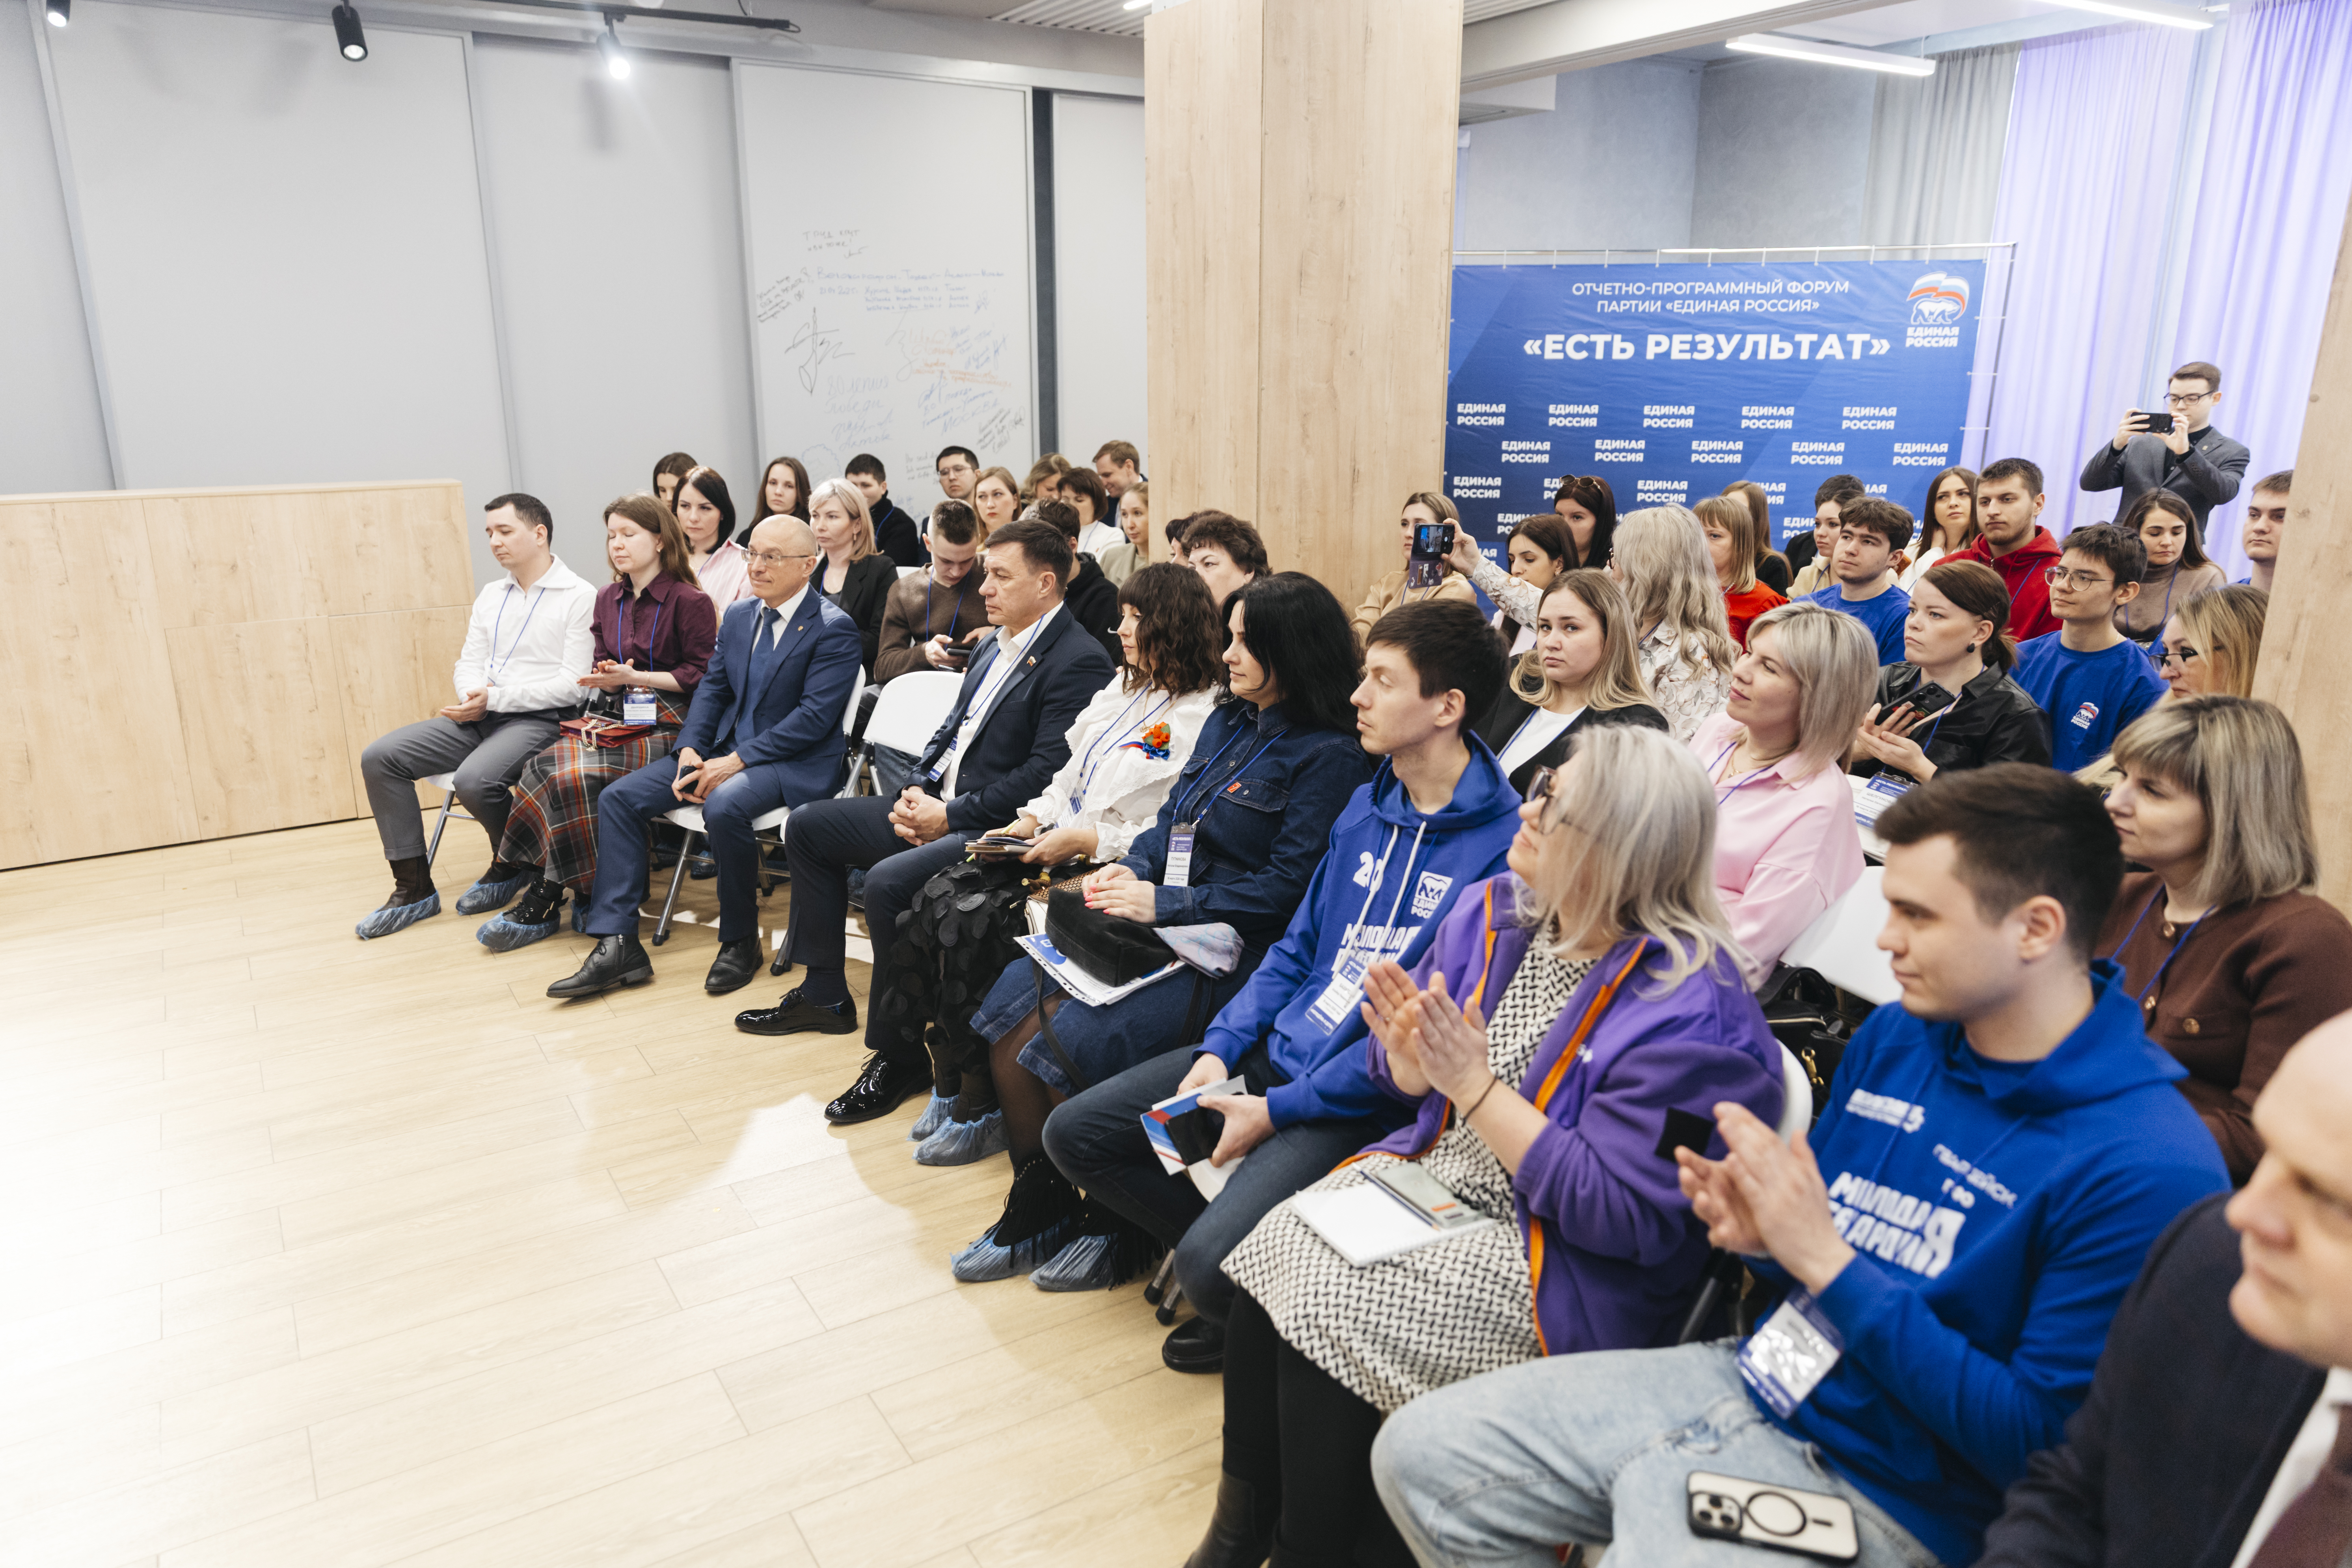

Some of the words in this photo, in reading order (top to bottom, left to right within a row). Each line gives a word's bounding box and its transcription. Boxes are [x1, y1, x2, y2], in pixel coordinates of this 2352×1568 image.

[1572, 279, 1783, 295] ОТЧЕТНО-ПРОГРАММНЫЙ
[1786, 280, 1849, 294] ФОРУМ
[1597, 300, 1661, 313] ПАРТИИ
[1665, 300, 1740, 315] «ЕДИНАЯ
[1744, 299, 1820, 313] РОССИЯ»
[1907, 326, 1960, 337] ЕДИНАЯ
[1523, 333, 1635, 360] «ЕСТЬ
[1646, 333, 1891, 361] РЕЗУЛЬТАТ»
[1905, 337, 1958, 348] РОССИЯ
[1457, 403, 1506, 414] ЕДИНАЯ
[1549, 404, 1599, 415] ЕДИНАЯ
[1643, 405, 1695, 416] ЕДИНАЯ
[1741, 406, 1795, 417] ЕДИНАЯ
[1842, 407, 1897, 418] ЕДИНАЯ
[1457, 416, 1505, 426] РОССИЯ
[1548, 417, 1598, 427] РОССИЯ
[1643, 418, 1693, 428] РОССИЯ
[1741, 419, 1793, 429] РОССИЯ
[1842, 420, 1895, 430] РОССИЯ
[1502, 441, 1551, 452] ЕДИНАЯ
[1595, 439, 1645, 450] ЕДИНАЯ
[1691, 441, 1743, 451] ЕДИНАЯ
[1791, 442, 1845, 453] ЕДИНАЯ
[1894, 443, 1949, 454] ЕДИНАЯ
[1501, 453, 1549, 463] РОССИЯ
[1595, 452, 1644, 462] РОССИЯ
[1691, 453, 1742, 464] РОССИЯ
[1791, 455, 1843, 465] РОССИЯ
[1892, 456, 1946, 466] РОССИЯ
[1453, 476, 1502, 487] ЕДИНАЯ
[1637, 480, 1688, 491] ЕДИНАЯ
[1453, 489, 1500, 498] РОССИЯ
[1865, 484, 1887, 493] НАЯ
[1637, 493, 1687, 503] РОССИЯ
[1783, 517, 1815, 528] ЕДИН
[2071, 719, 2088, 729] РОССИЯ
[1866, 792, 1892, 804] ШЕЛГУНОВ
[1413, 897, 1439, 911] ЕДИН
[1411, 905, 1434, 919] РОС
